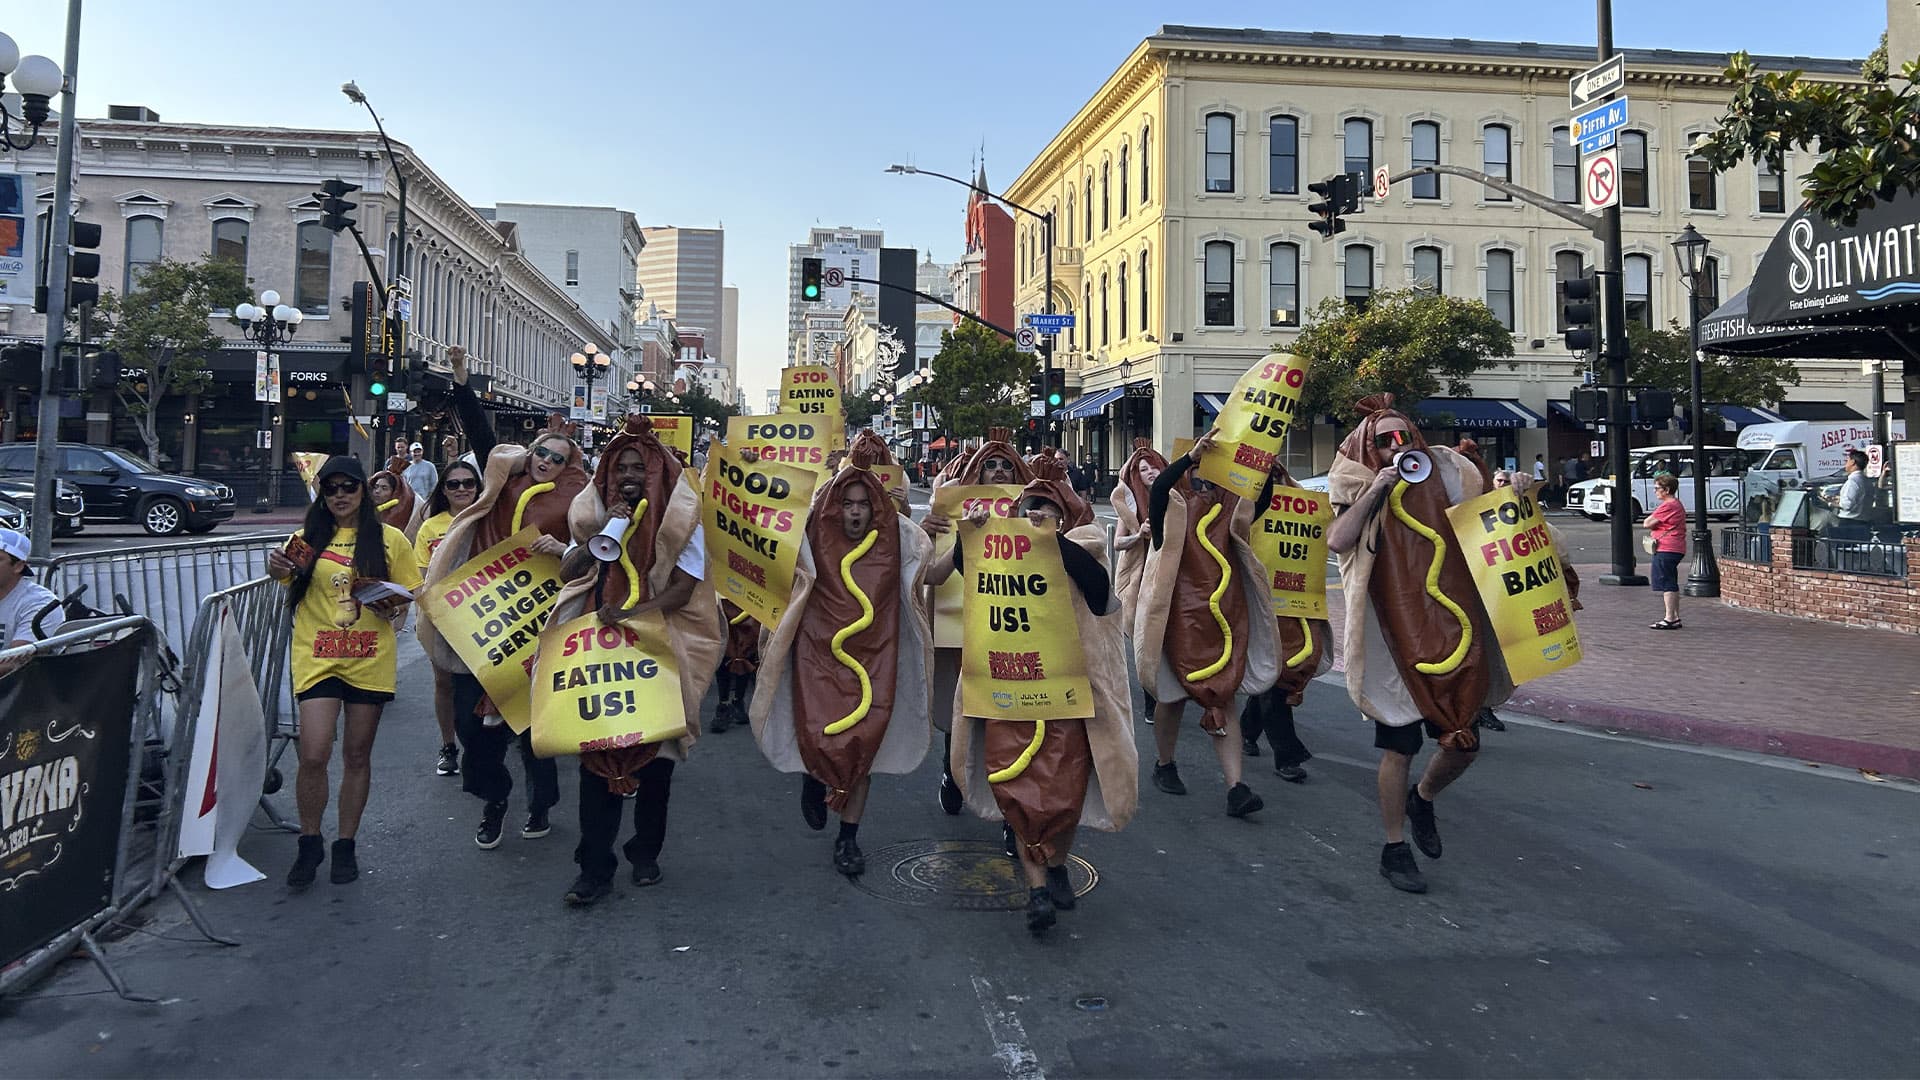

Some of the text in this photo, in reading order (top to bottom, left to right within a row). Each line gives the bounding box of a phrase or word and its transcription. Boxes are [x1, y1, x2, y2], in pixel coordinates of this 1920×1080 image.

[1587, 70, 1616, 92] ONE WAY
[1582, 108, 1623, 135] FIFTH AV.
[1789, 218, 1920, 294] SALTWAT
[1789, 294, 1849, 310] Fine Dining Cuisine
[1032, 316, 1060, 325] MARKET
[1701, 321, 1719, 341] FRESH
[1720, 318, 1745, 338] FISH
[1747, 323, 1756, 335] &
[290, 371, 328, 382] FORKS
[793, 371, 829, 385] STOP
[1259, 362, 1304, 388] STO
[789, 388, 835, 399] EATING
[1244, 387, 1299, 415] EATIN
[799, 402, 825, 414] US!
[747, 424, 815, 440] FOOD
[1820, 425, 1847, 450] ASAP
[719, 457, 791, 500] FOOD
[712, 480, 794, 533] FIGHTS
[962, 497, 1013, 516] STO
[1270, 494, 1319, 516] STOP
[1479, 496, 1534, 533] FOOD
[716, 510, 779, 561] BACK!
[1264, 519, 1322, 539] EATING
[983, 534, 1032, 560] STOP
[1279, 541, 1308, 561] US!
[1480, 524, 1550, 567] FIGHTS
[444, 546, 533, 608] DINNER
[978, 572, 1047, 596] EATING
[1501, 556, 1559, 597] BACK!
[472, 570, 533, 619] IS NO
[472, 579, 562, 648] LONGER
[989, 606, 1031, 633] US!
[487, 603, 556, 666] SERVE
[563, 625, 640, 656] STOP
[553, 659, 659, 692] EATING
[578, 690, 637, 721] US!
[992, 691, 1013, 701] prime
